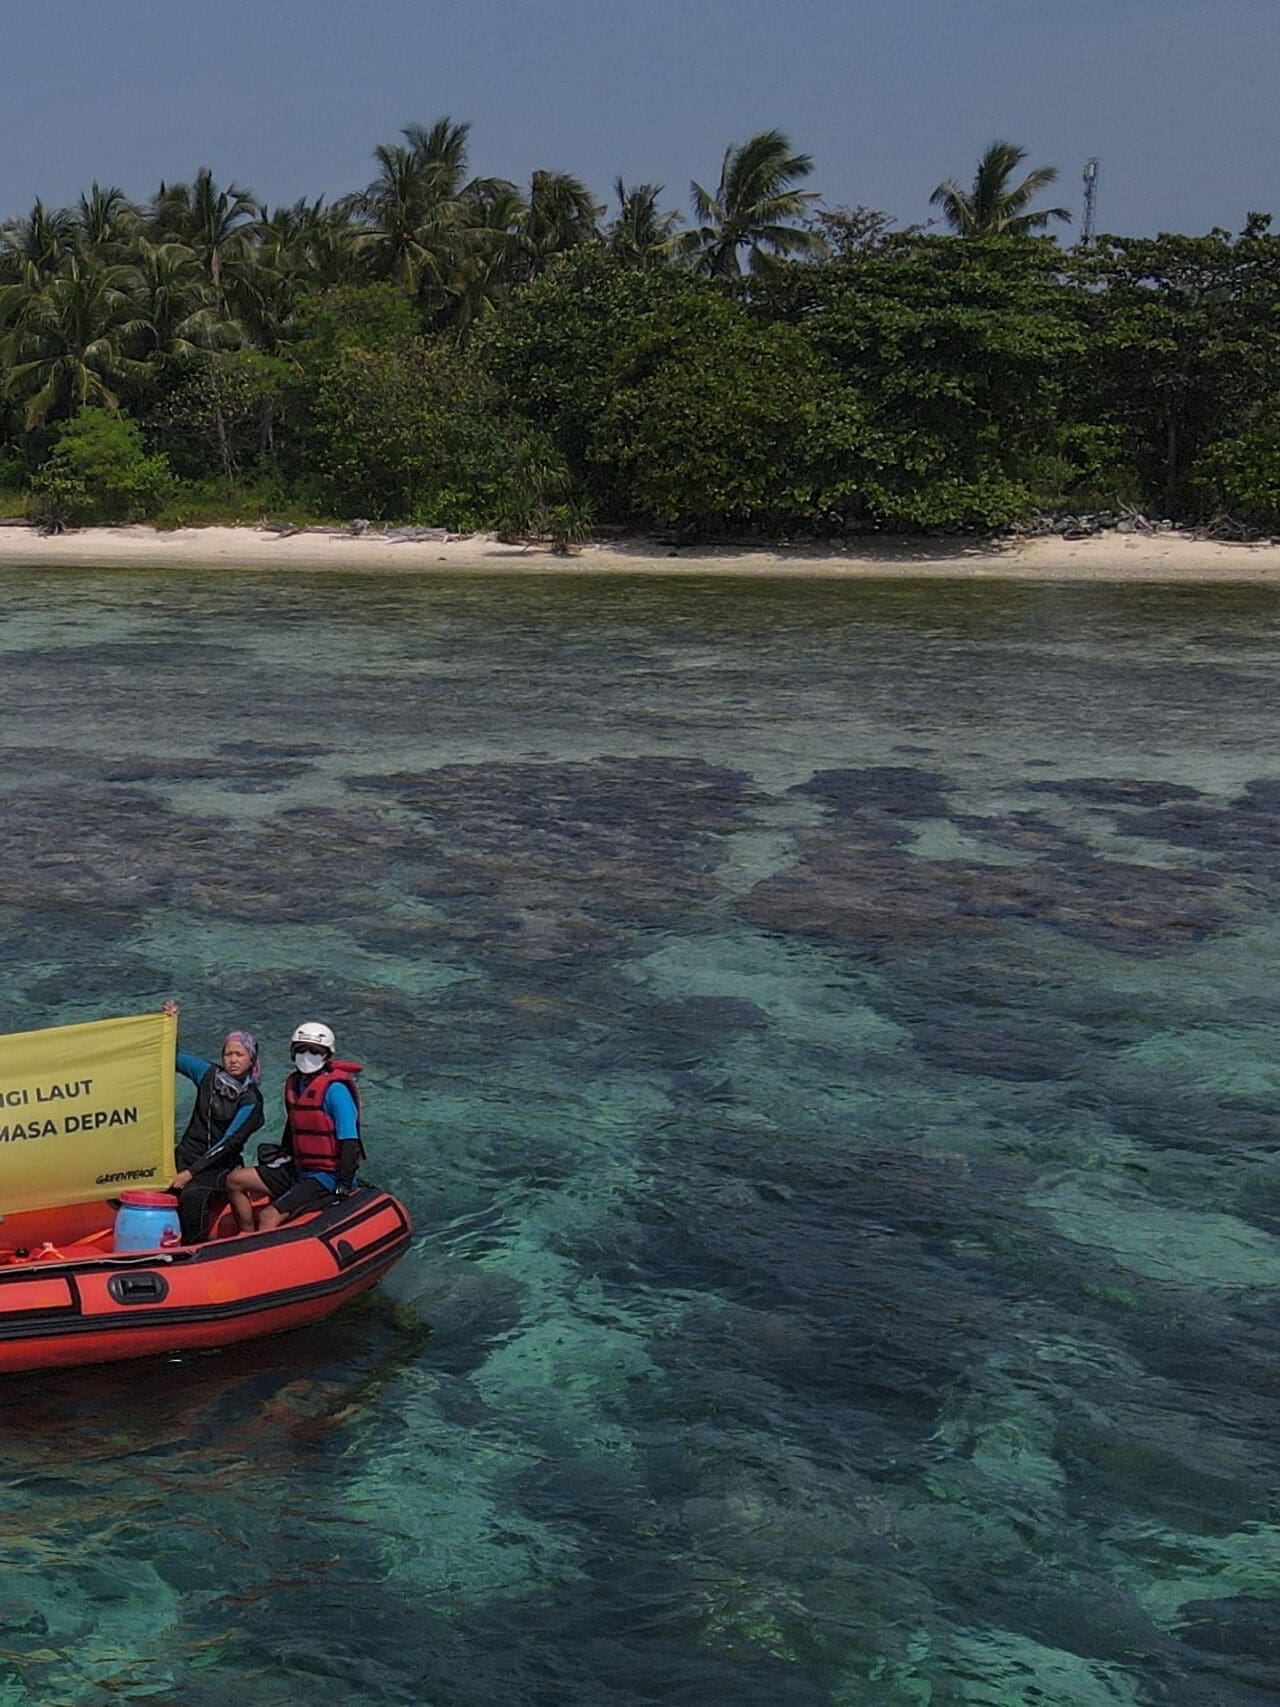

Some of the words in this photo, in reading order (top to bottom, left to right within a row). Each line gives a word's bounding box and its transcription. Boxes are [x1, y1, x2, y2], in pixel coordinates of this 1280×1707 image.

[35, 1079, 93, 1102] LAUT
[64, 1107, 138, 1133] DEPAN
[95, 1167, 157, 1185] GREENPEACE
